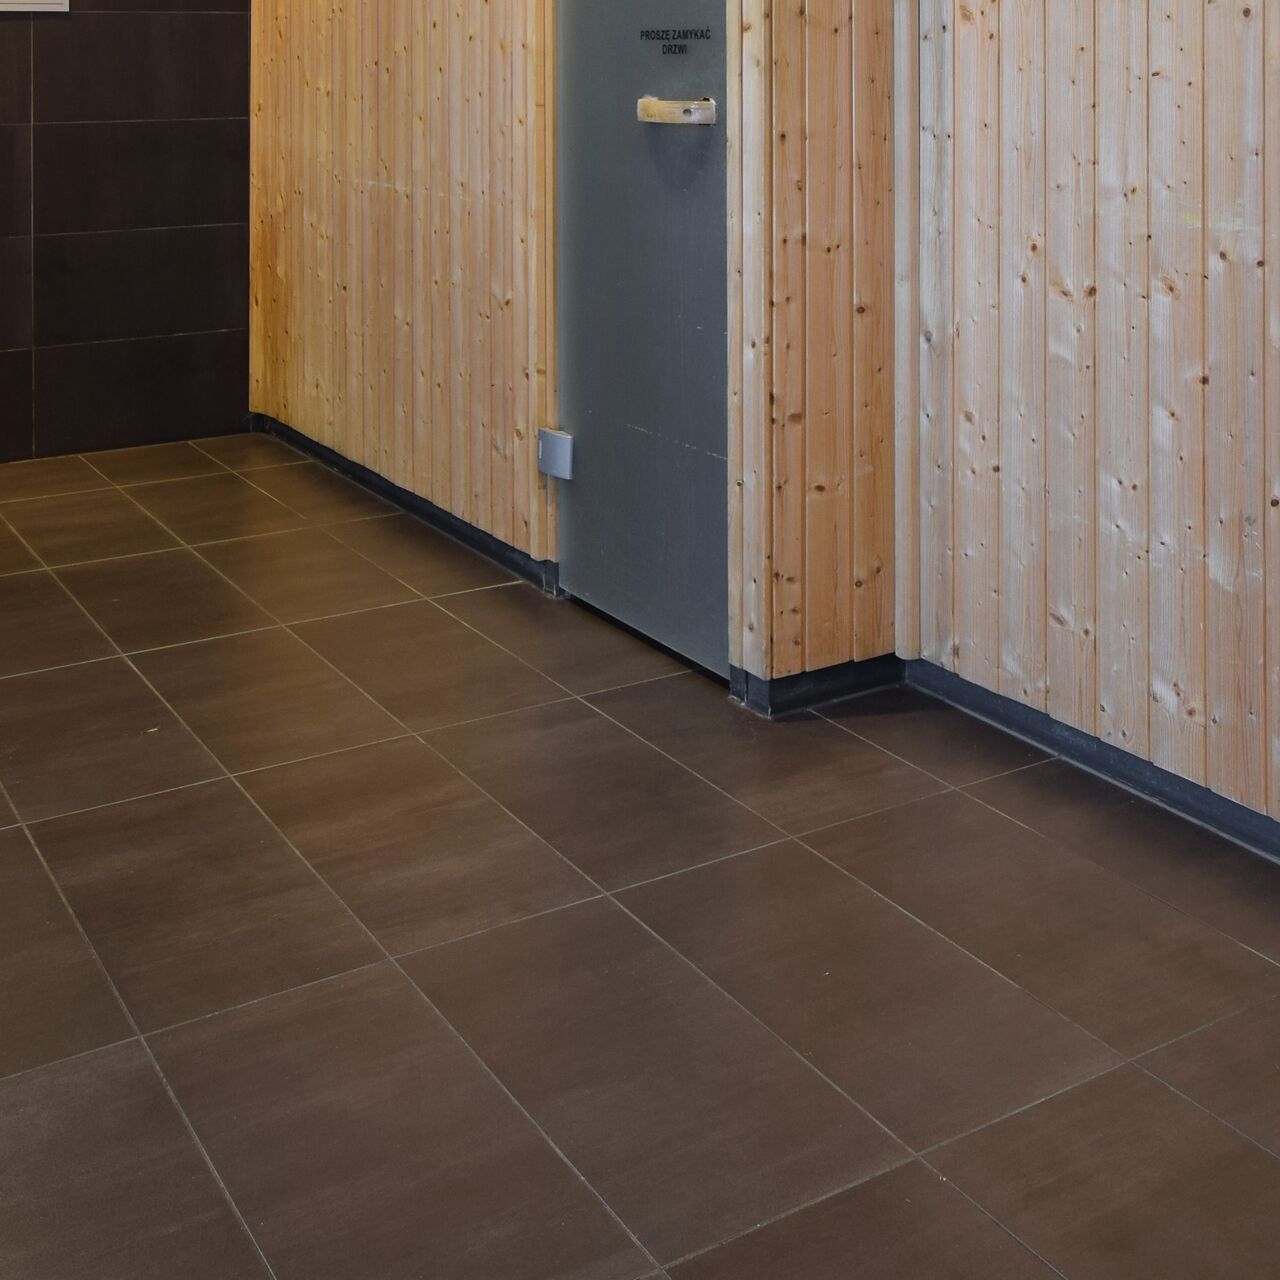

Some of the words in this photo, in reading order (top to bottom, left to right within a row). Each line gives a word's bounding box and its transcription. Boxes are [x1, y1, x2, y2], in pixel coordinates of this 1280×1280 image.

[640, 29, 670, 42] PROSZĘ
[672, 26, 711, 41] ZAMYKAĆ
[662, 44, 687, 55] DRZWI
